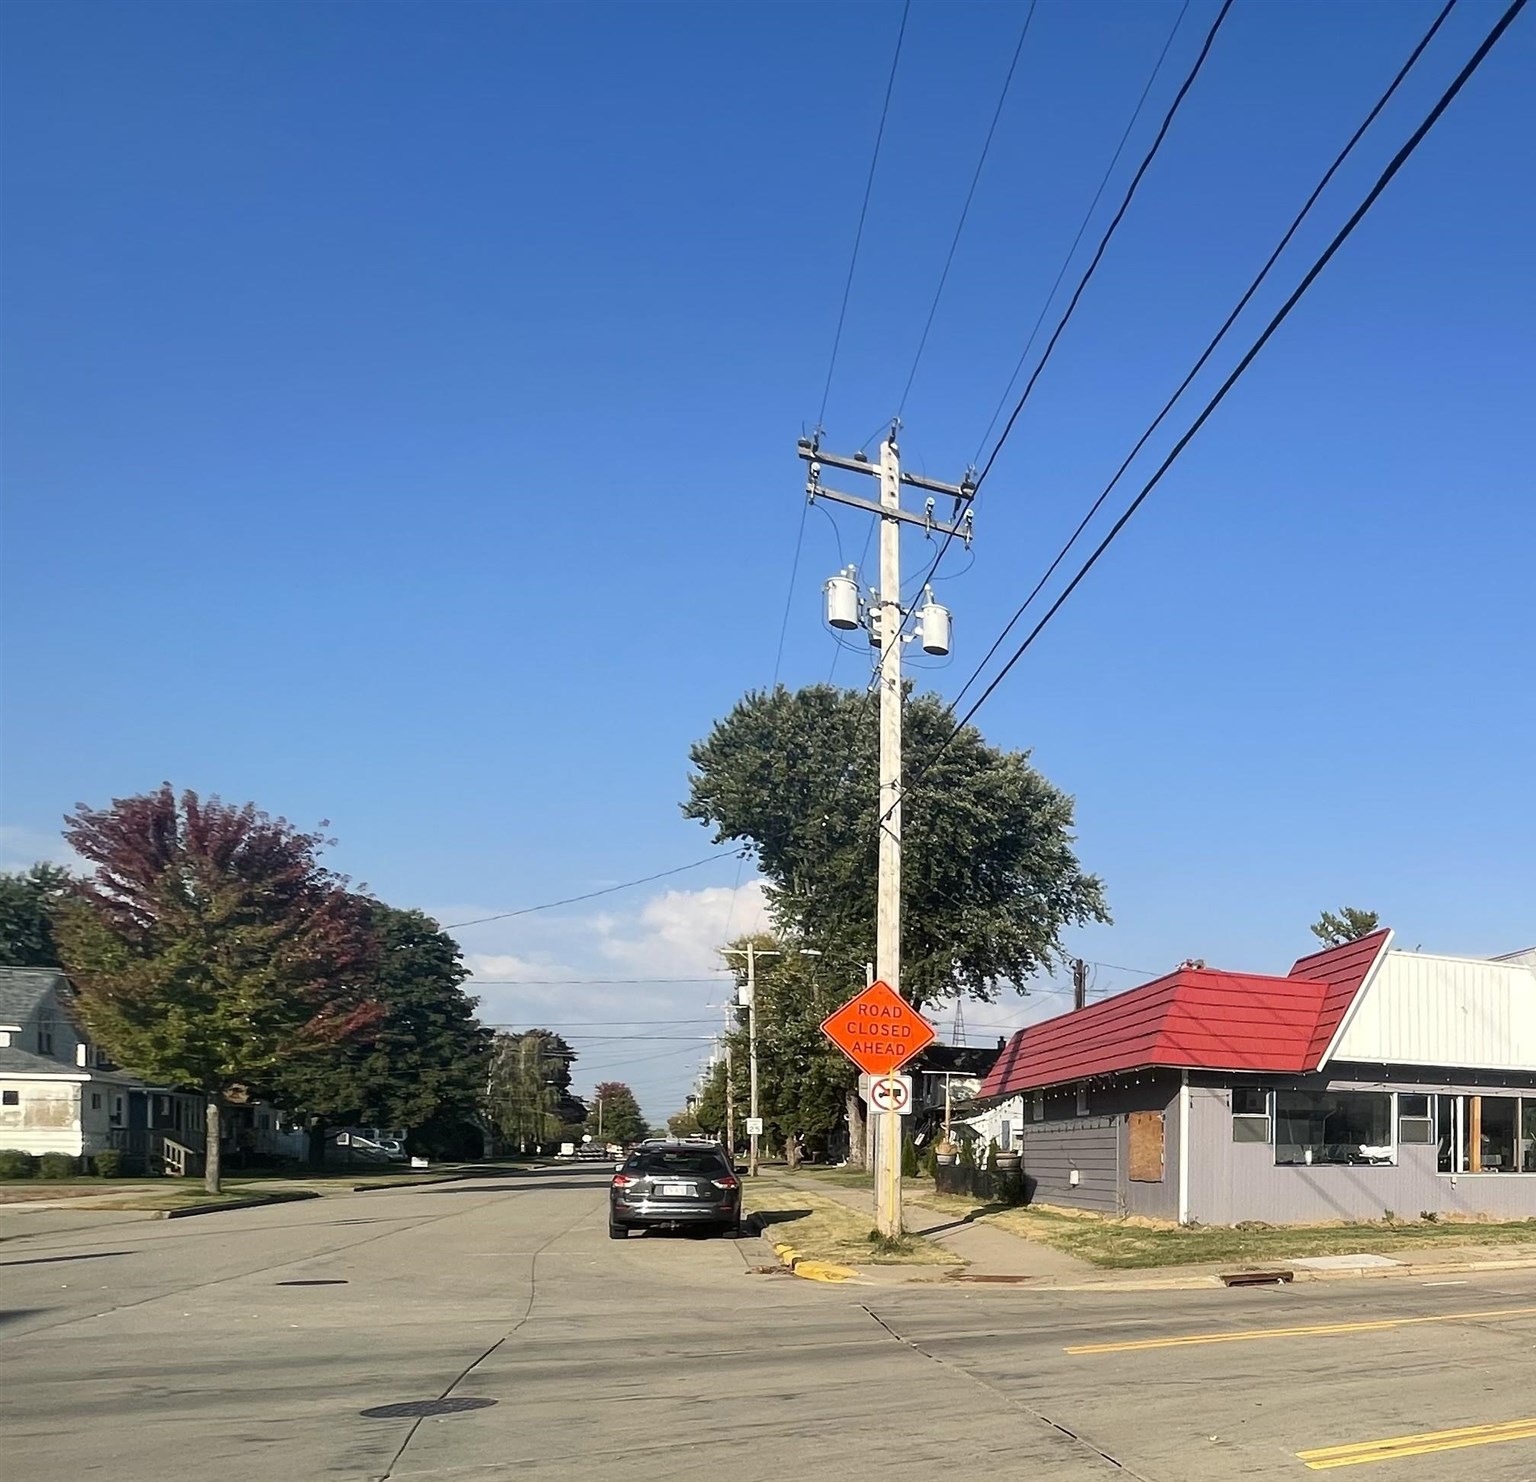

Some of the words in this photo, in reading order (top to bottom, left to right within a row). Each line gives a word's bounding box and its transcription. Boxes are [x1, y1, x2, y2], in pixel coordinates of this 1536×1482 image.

[858, 1004, 903, 1018] ROAD
[847, 1022, 911, 1038] CLOSED
[852, 1041, 906, 1056] AHEAD
[749, 1125, 761, 1133] 25
